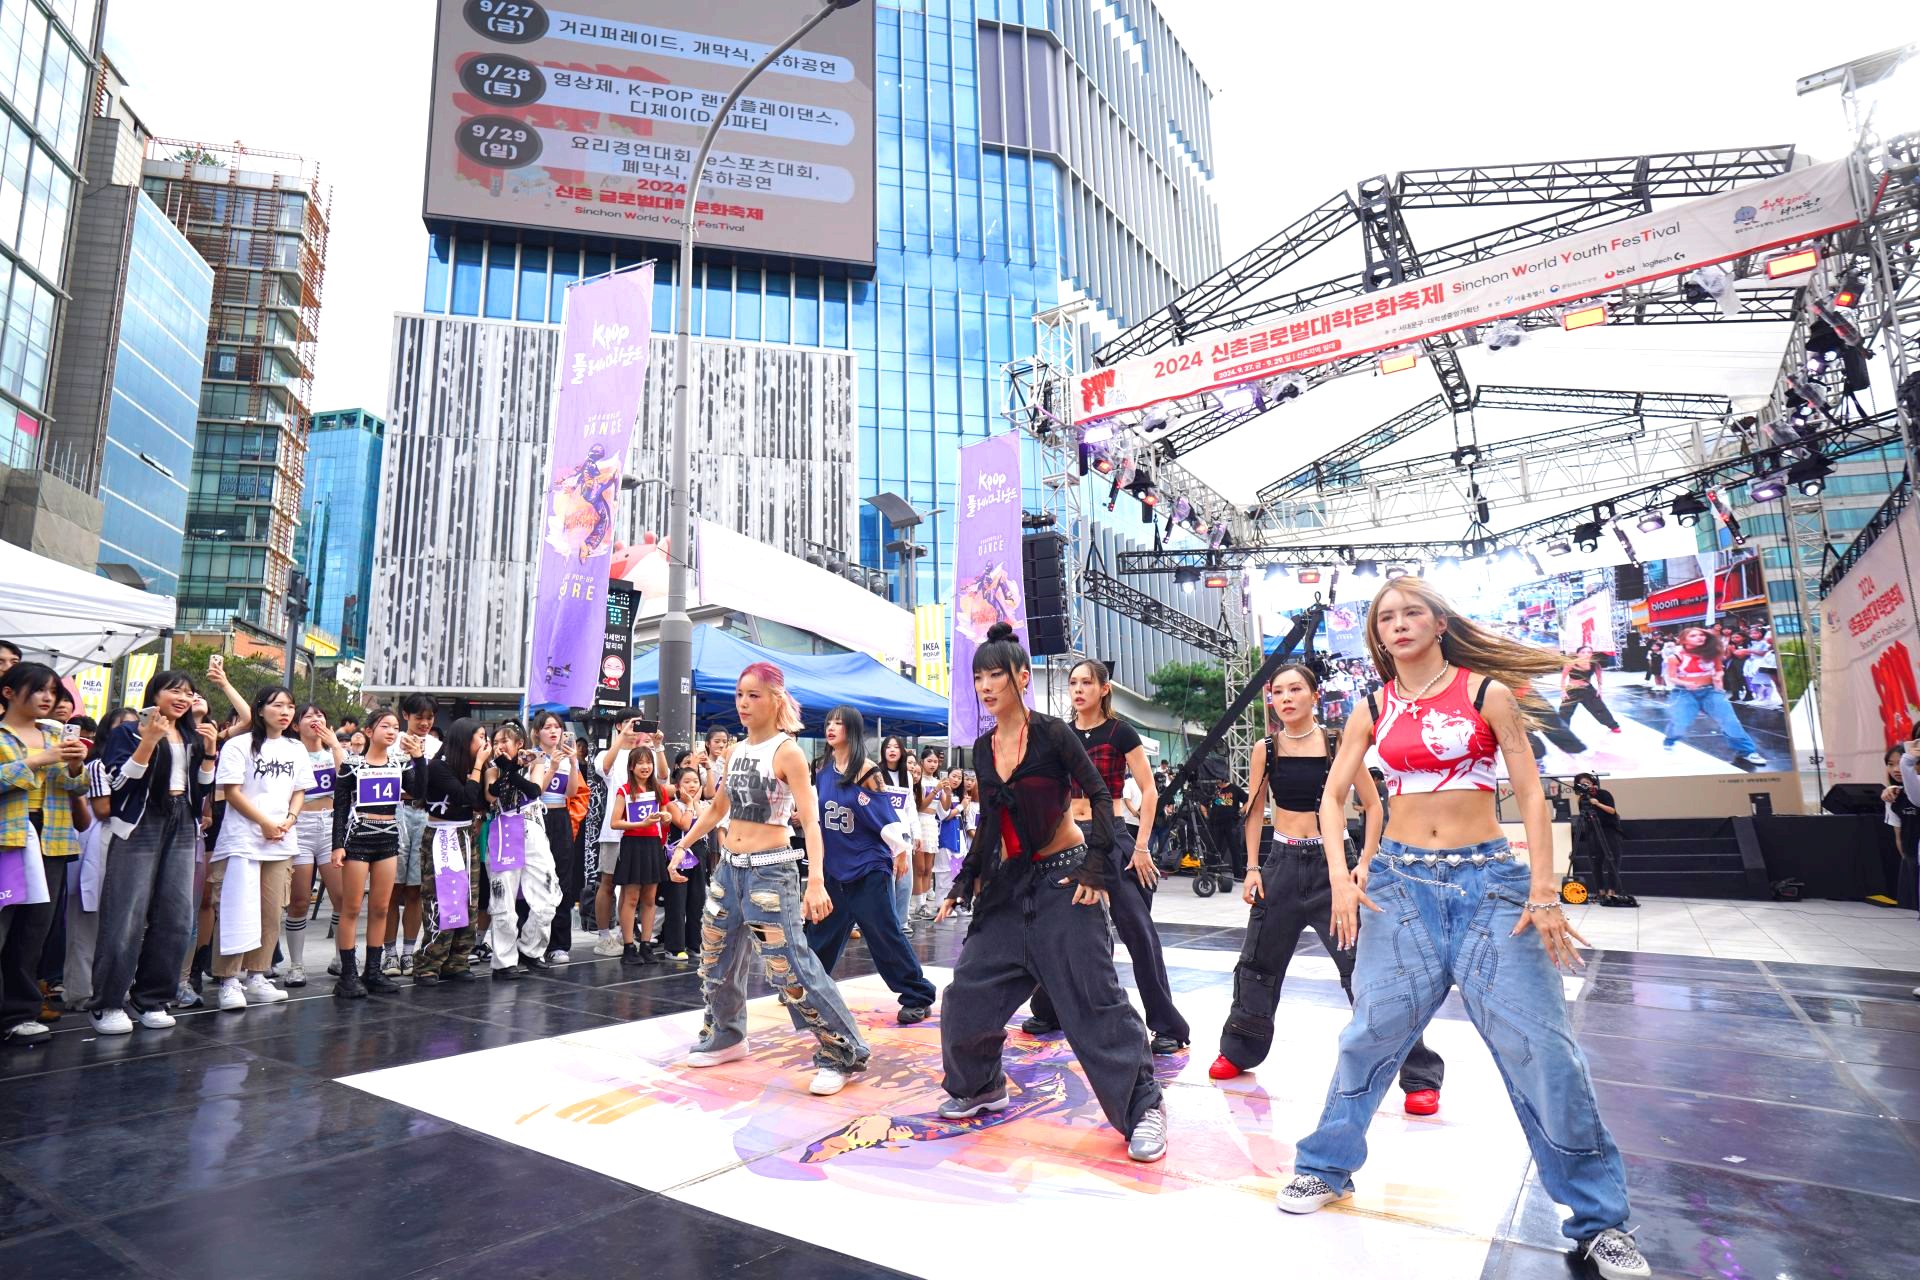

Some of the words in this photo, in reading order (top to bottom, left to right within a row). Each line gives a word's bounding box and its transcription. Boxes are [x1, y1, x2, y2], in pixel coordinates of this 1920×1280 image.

[479, 0, 534, 19] 9/27
[487, 16, 525, 35] (금)
[559, 19, 685, 52] 거리퍼레이드,
[693, 40, 755, 63] 개막식,
[475, 62, 531, 82] 9/28
[483, 80, 521, 98] (토)
[554, 72, 620, 95] 영상제,
[629, 83, 693, 103] K-POP
[630, 100, 768, 131] 디제이(D)파티
[472, 124, 527, 143] 9/29
[479, 141, 518, 160] (일)
[622, 159, 687, 181] 폐막식,
[706, 154, 820, 181] e스포츠대회,
[555, 184, 593, 201] 신촌
[637, 178, 687, 194] 2024
[575, 206, 622, 219] Sinchon
[624, 211, 659, 223] World
[662, 215, 695, 228] You
[698, 220, 745, 232] FesTival
[1642, 255, 1673, 268] logitech
[1154, 351, 1203, 378] 2024
[1211, 282, 1445, 364] 신촌글로벌대학문화축제
[1452, 271, 1509, 294] Sinchon
[1512, 256, 1557, 277] World
[1561, 244, 1608, 264] Youth
[1611, 221, 1680, 251] FesTival
[592, 319, 629, 351] Kpop
[1218, 369, 1236, 379] 2024.
[978, 469, 1007, 492] Kpop
[1650, 598, 1680, 611] bloom
[923, 642, 940, 651] IKEA
[731, 757, 761, 772] HOT
[372, 782, 393, 799] 14
[638, 804, 653, 819] 37
[890, 796, 902, 808] 28
[824, 799, 855, 834] 23
